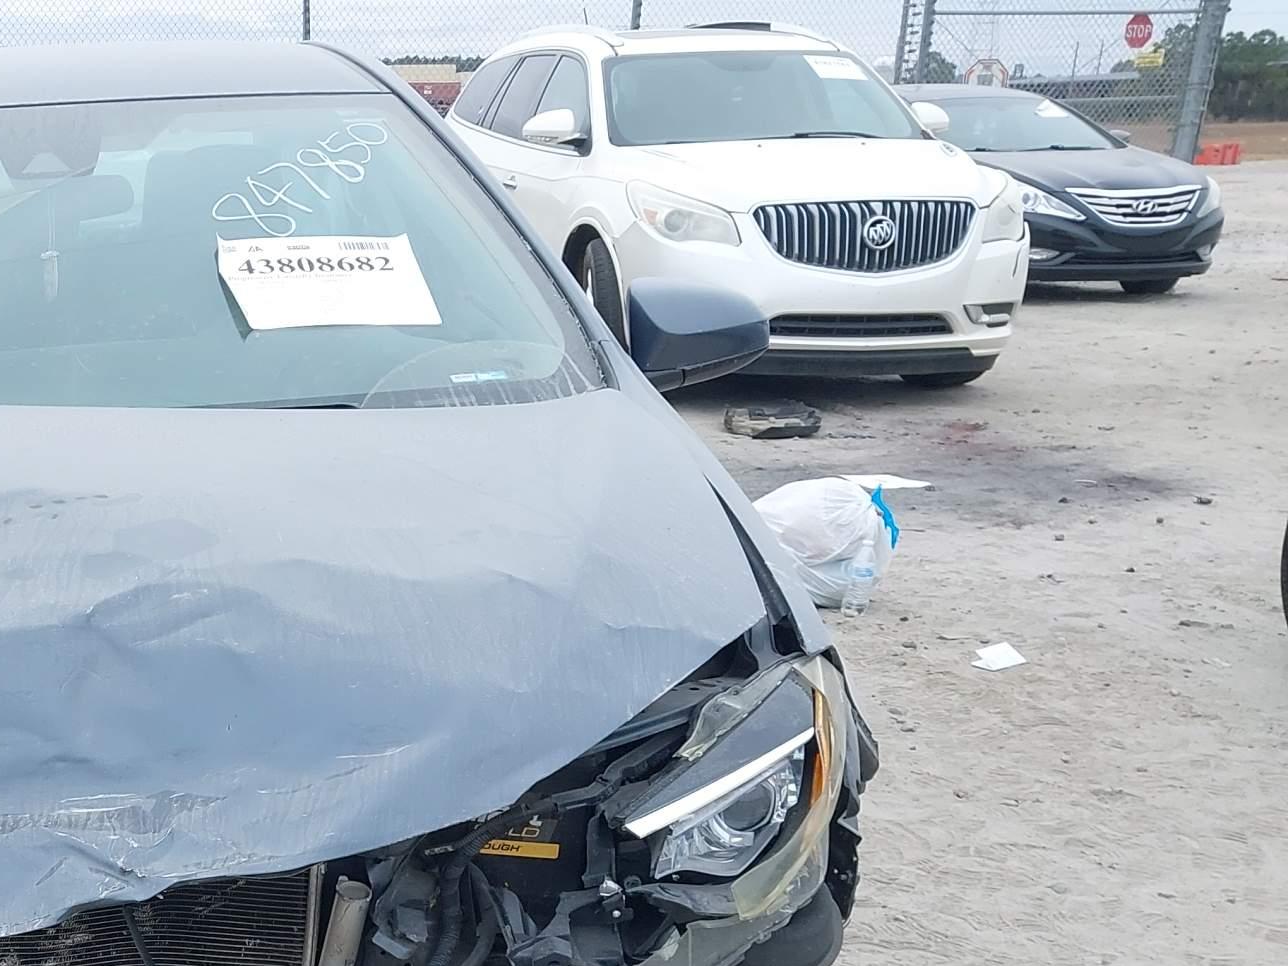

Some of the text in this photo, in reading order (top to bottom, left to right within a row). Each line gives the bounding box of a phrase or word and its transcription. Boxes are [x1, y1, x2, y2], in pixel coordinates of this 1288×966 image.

[1126, 24, 1152, 38] STOP
[212, 123, 388, 236] 847850
[238, 256, 394, 274] 43808682
[483, 842, 520, 852] OUGH
